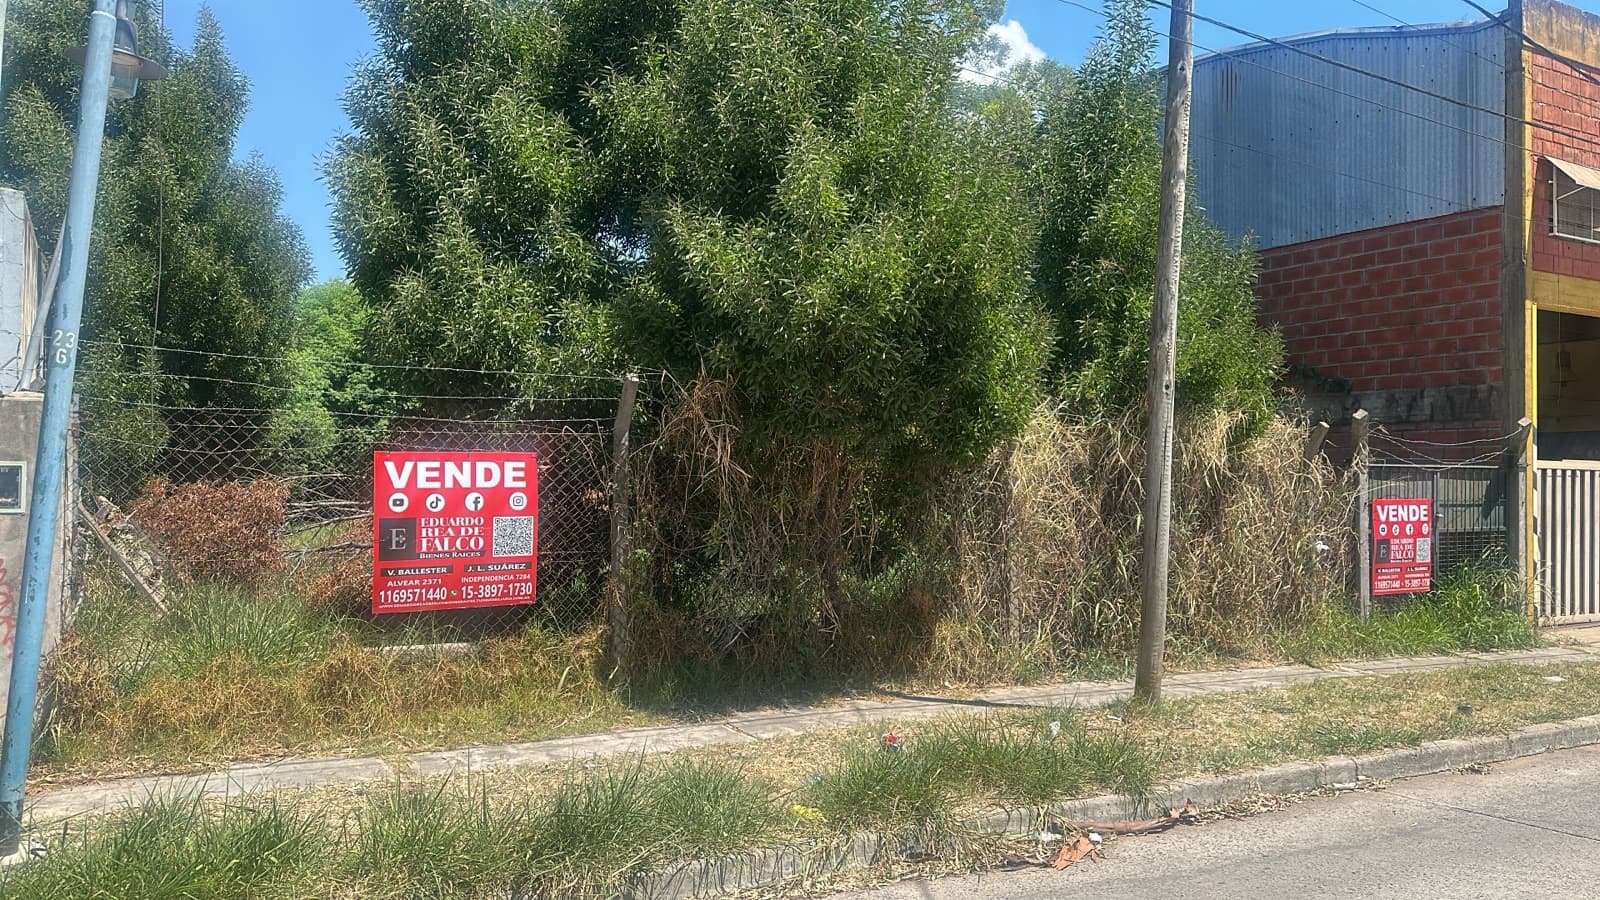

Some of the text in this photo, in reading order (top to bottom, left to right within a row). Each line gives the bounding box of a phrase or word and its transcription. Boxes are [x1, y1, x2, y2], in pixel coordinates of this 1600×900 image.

[53, 329, 75, 348] 23
[384, 461, 527, 489] VENDE
[1376, 505, 1429, 521] VENDE
[420, 516, 485, 527] EDUARDO
[421, 526, 485, 537] REA DE
[421, 536, 485, 552] FALCO
[1391, 550, 1414, 560] FALCO
[398, 567, 448, 575] BALLESTER
[487, 563, 527, 571] SUÁREZ
[387, 579, 420, 587] ALVEAR
[461, 574, 515, 583] INDEPENDENCIA
[379, 586, 448, 604] 1169571440
[461, 582, 533, 599] 15-3897-1730
